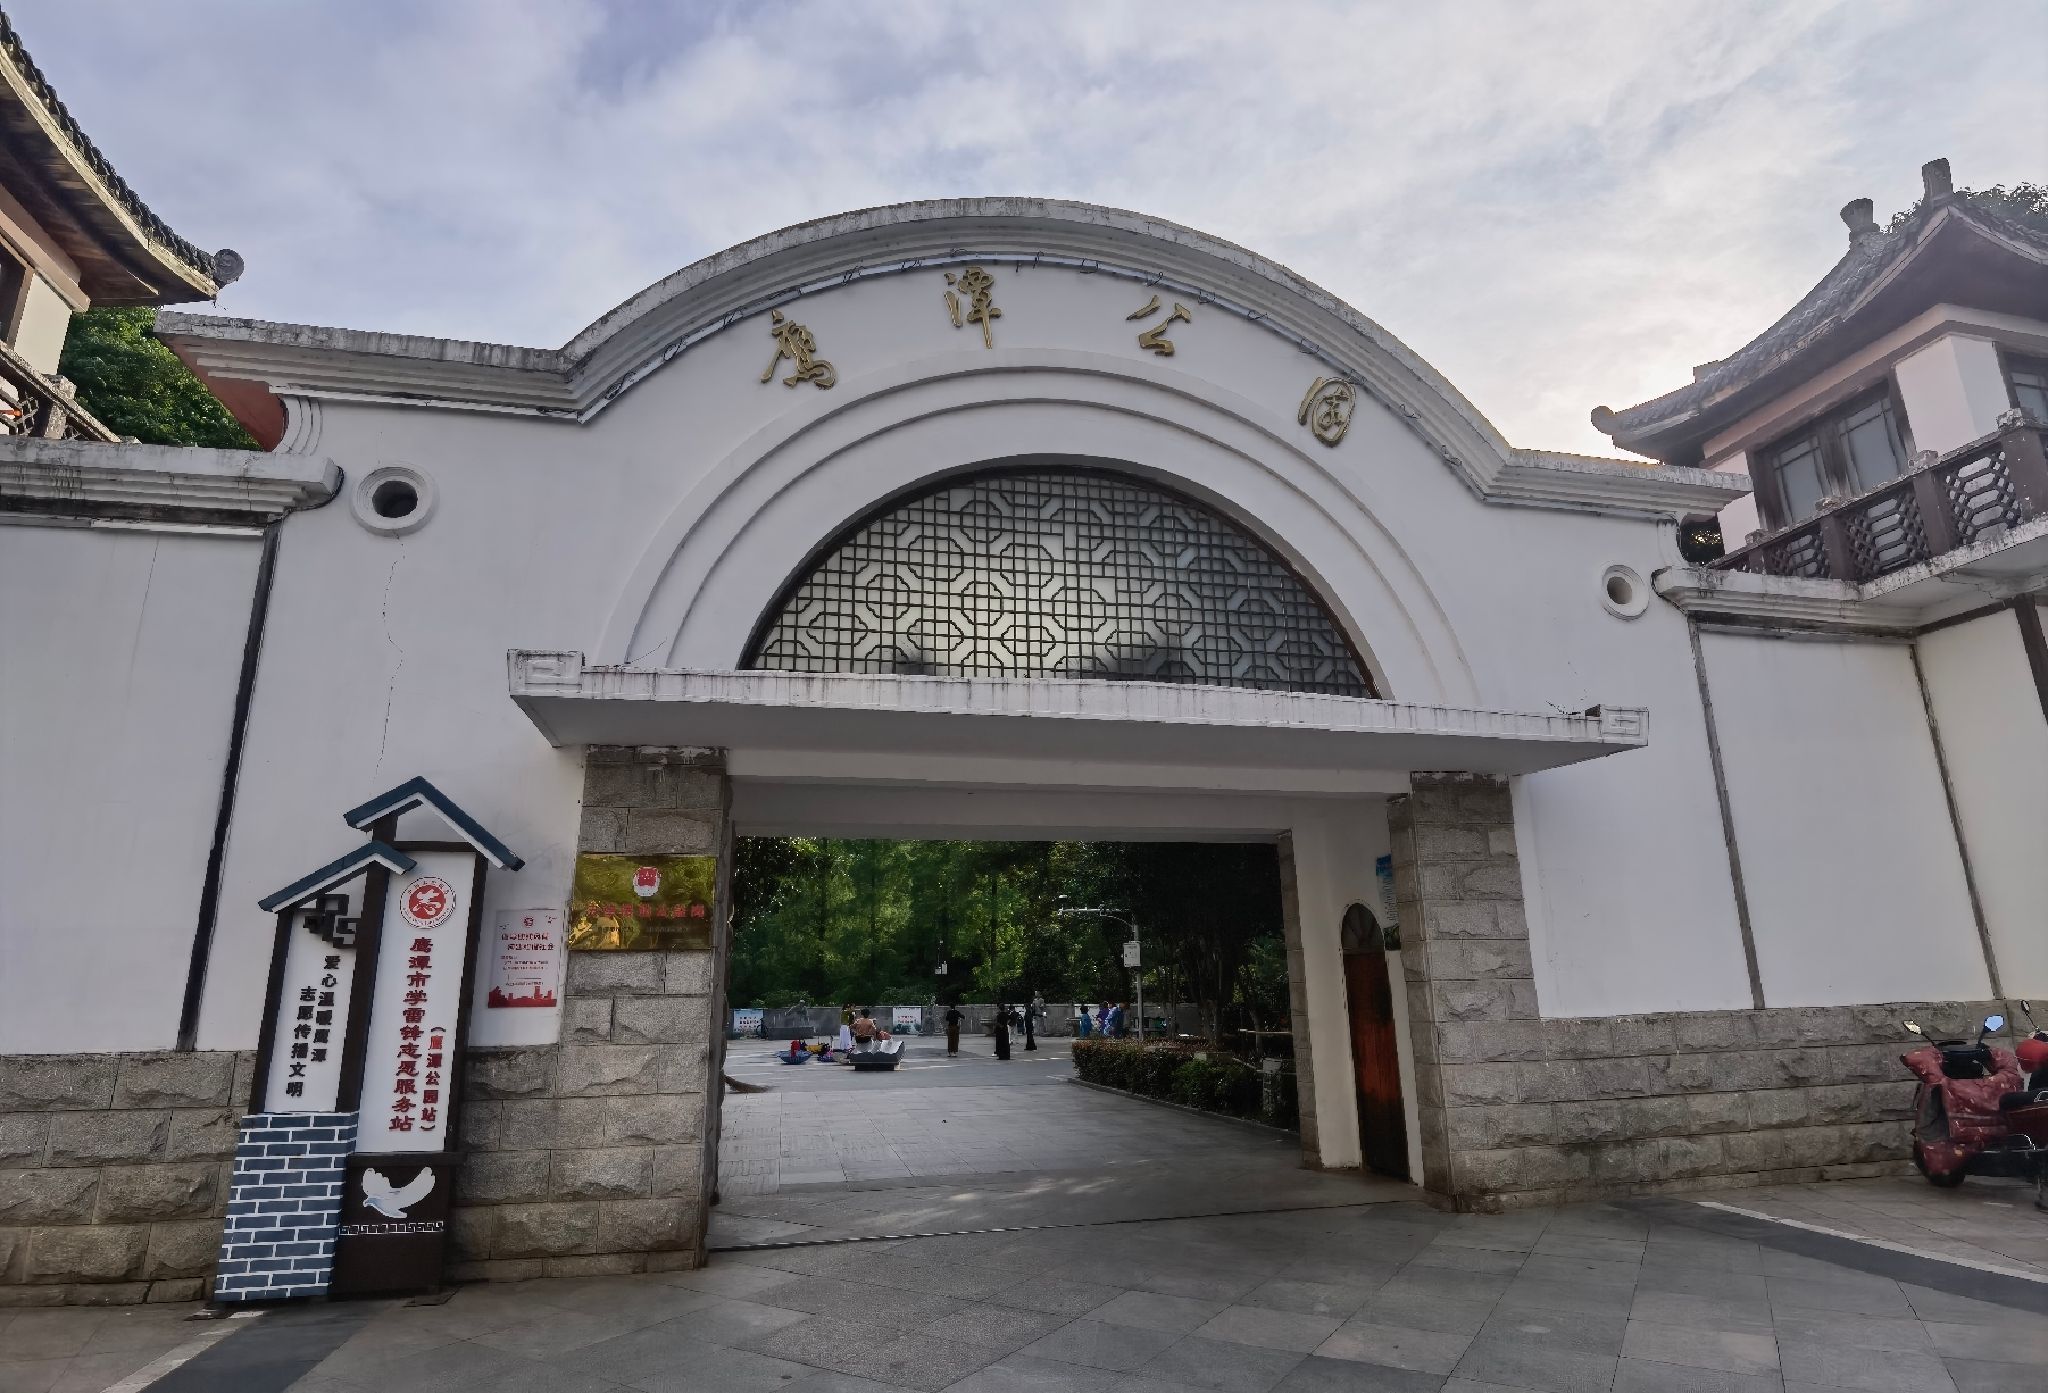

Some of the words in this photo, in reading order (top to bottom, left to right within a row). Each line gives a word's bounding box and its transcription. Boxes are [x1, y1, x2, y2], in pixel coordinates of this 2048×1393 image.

[285, 985, 317, 1098] 志愿传播文明
[311, 955, 341, 1062] 爱心温暖鹰潭
[388, 936, 434, 1132] 鹰潭市学雷锋志愿服务站
